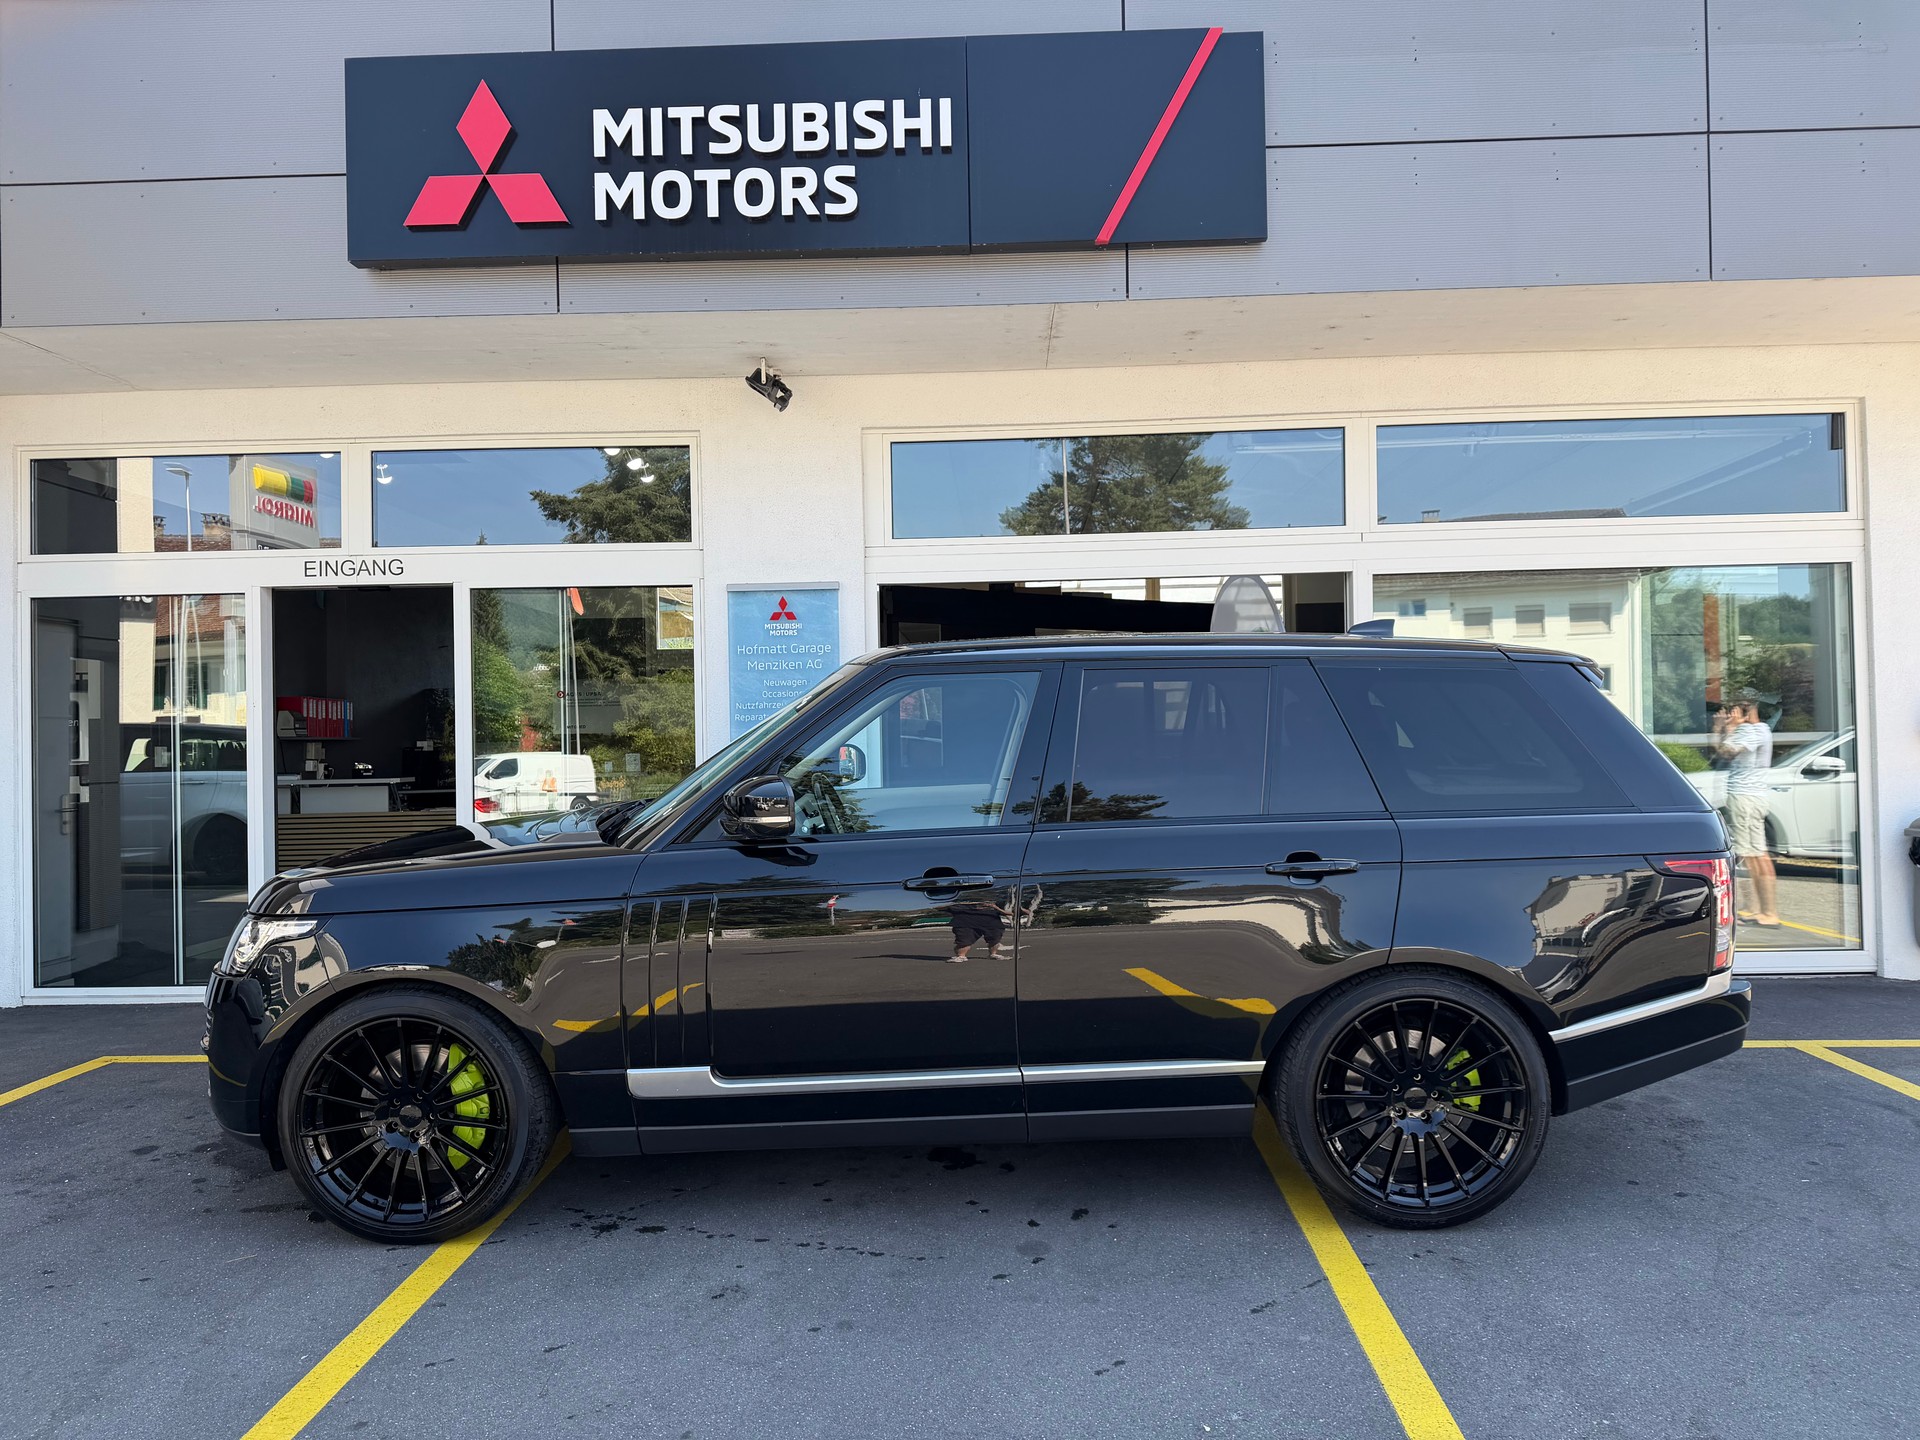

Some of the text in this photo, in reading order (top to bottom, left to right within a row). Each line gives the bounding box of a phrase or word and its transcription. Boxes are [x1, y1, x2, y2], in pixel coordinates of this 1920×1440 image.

[592, 97, 952, 158] MITSUBISHI
[593, 165, 859, 222] MOTORS
[304, 559, 404, 577] EINGANG
[737, 643, 831, 655] Hofmatt Garage
[747, 659, 823, 671] Menziken AG
[763, 679, 808, 688] Neuwagen
[734, 714, 769, 722] Reparat
